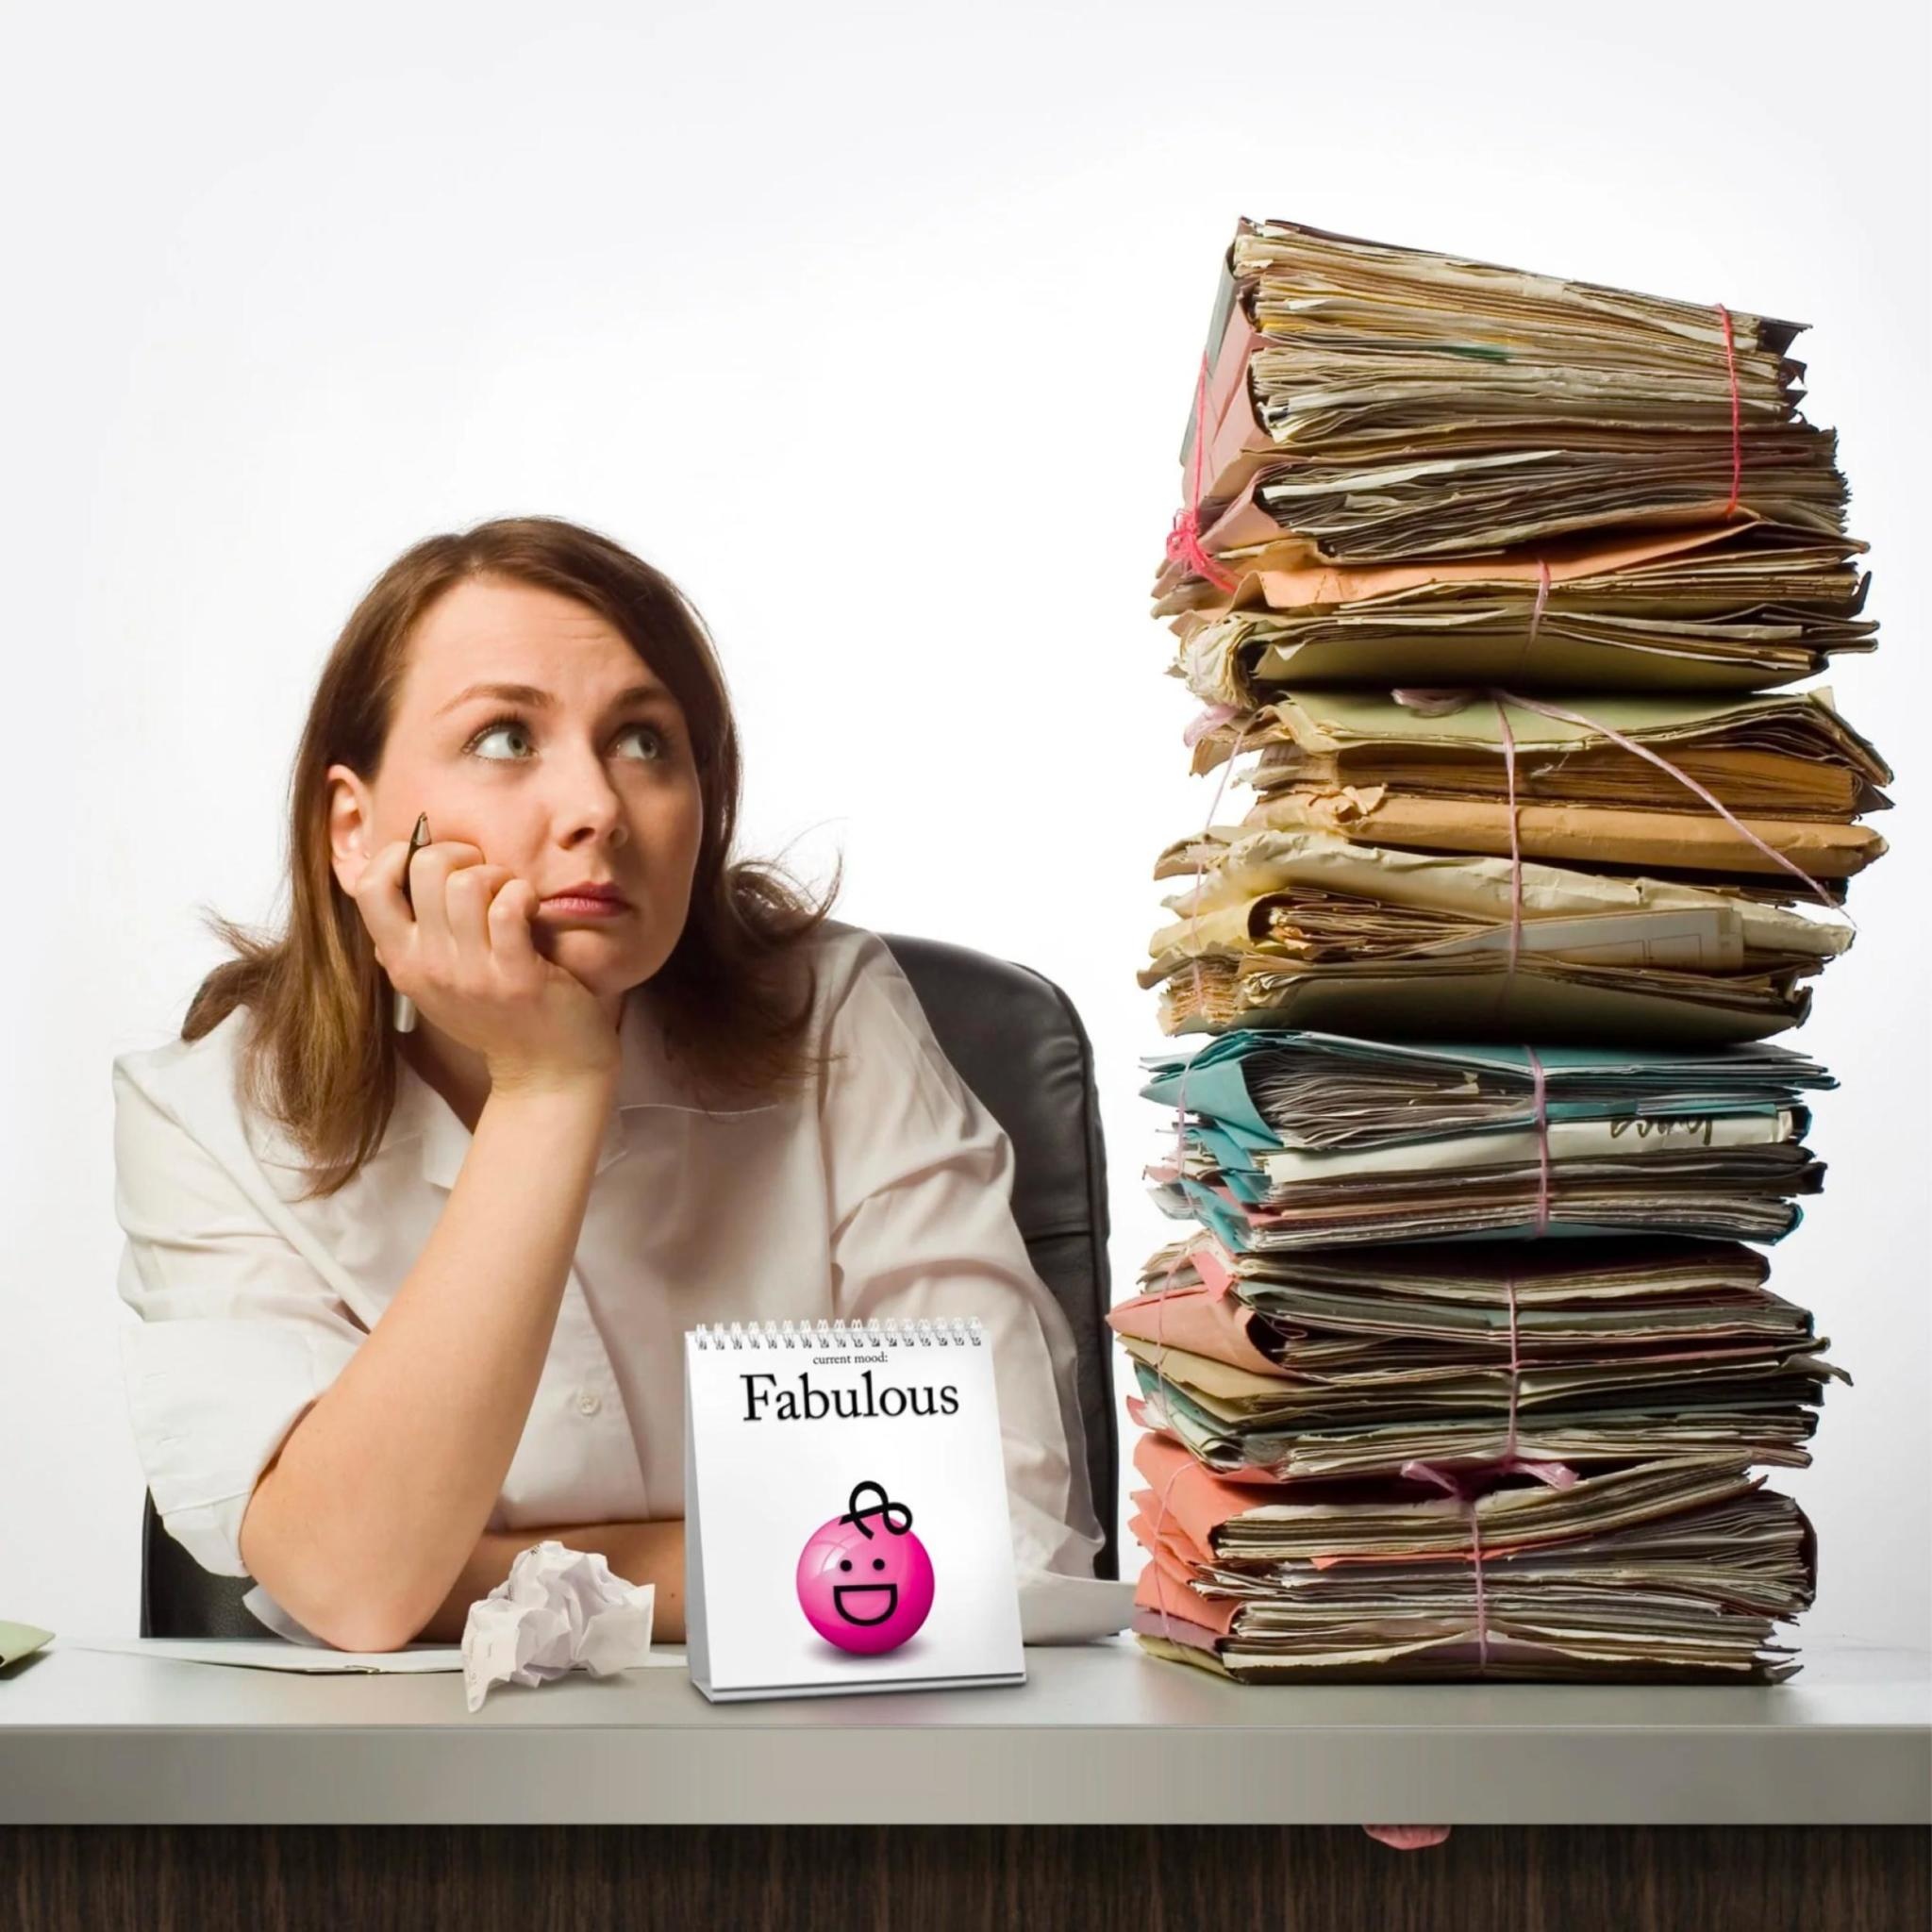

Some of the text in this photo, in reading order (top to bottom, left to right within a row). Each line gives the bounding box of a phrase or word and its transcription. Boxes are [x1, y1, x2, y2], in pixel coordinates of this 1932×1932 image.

[812, 1351, 889, 1365] current mood:
[740, 1370, 959, 1422] Fabulous
